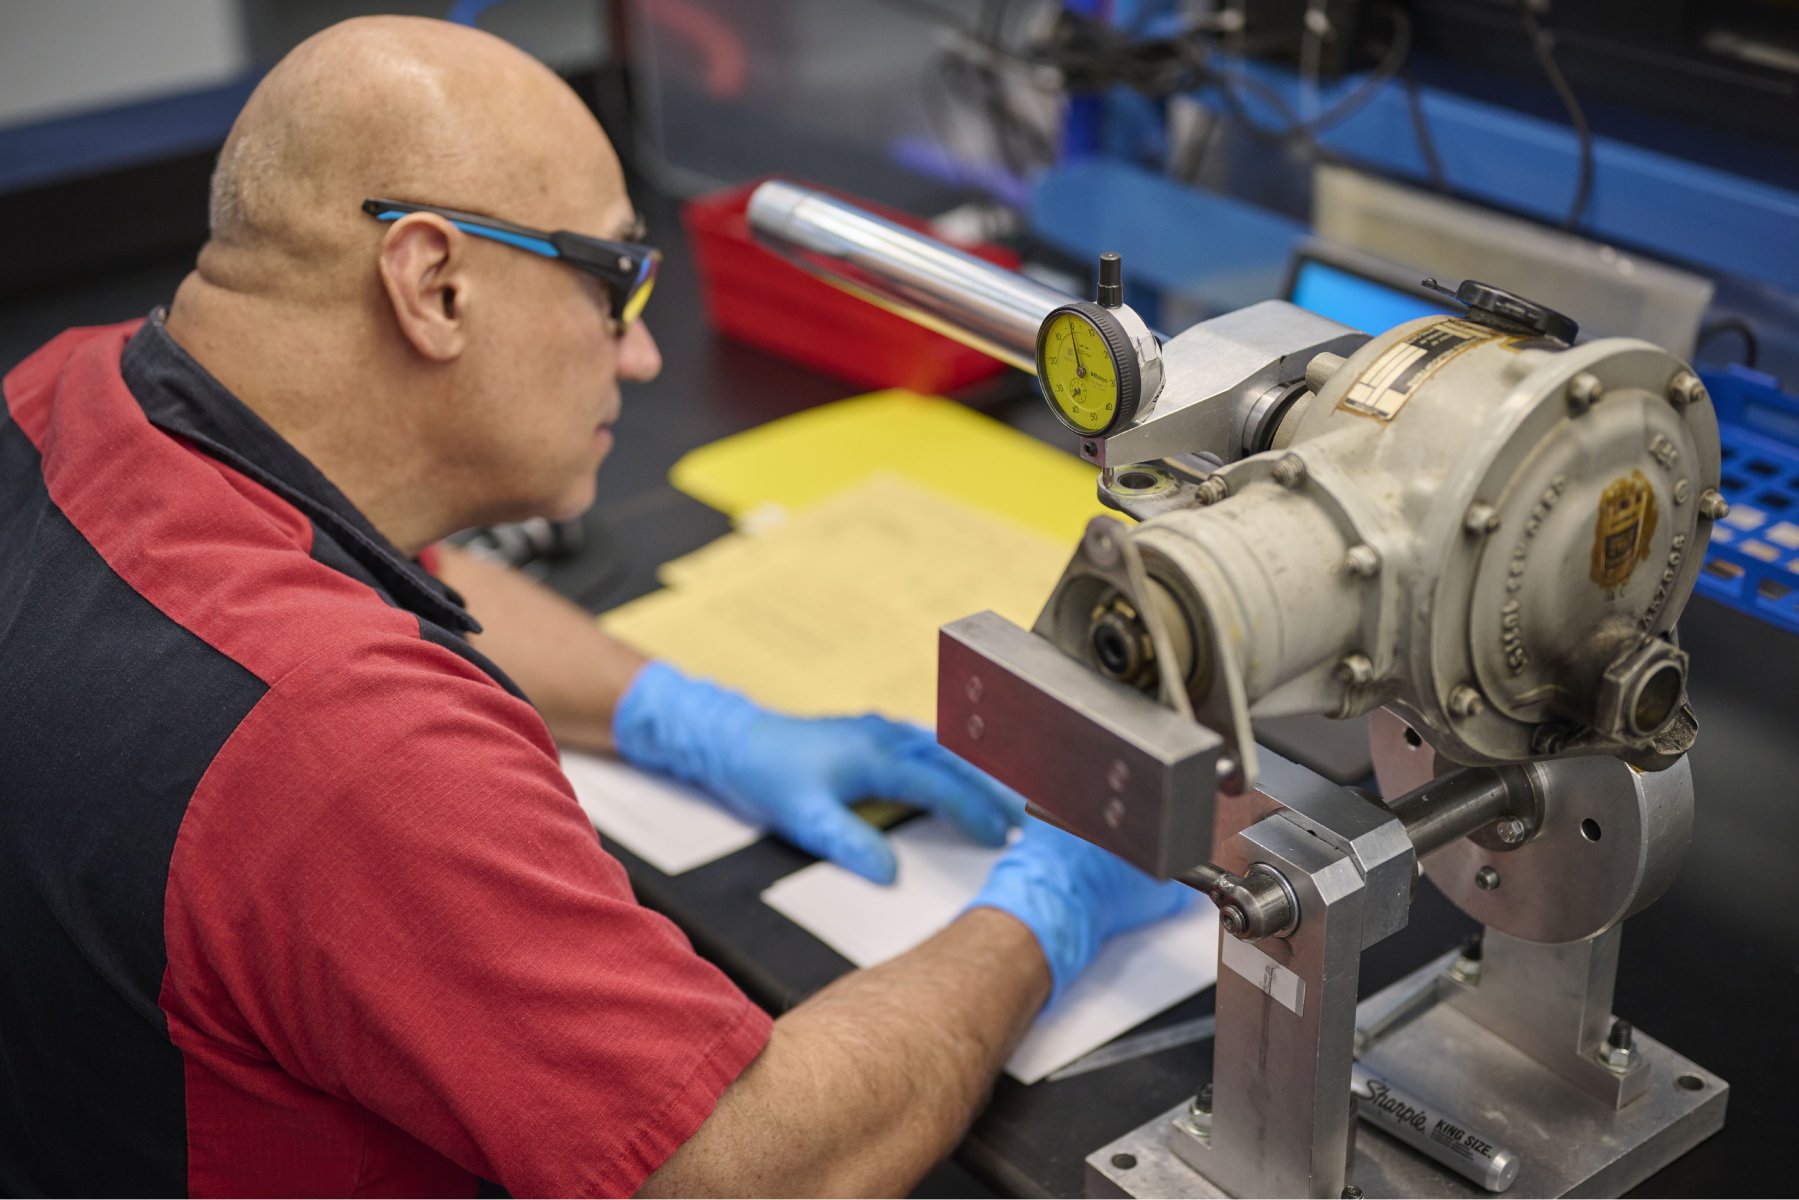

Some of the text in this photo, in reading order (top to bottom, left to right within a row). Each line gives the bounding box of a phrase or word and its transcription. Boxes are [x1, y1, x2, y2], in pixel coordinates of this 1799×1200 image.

[1090, 412, 1098, 421] 50
[1354, 1079, 1427, 1133] Sharpie
[1434, 1119, 1466, 1141] KING
